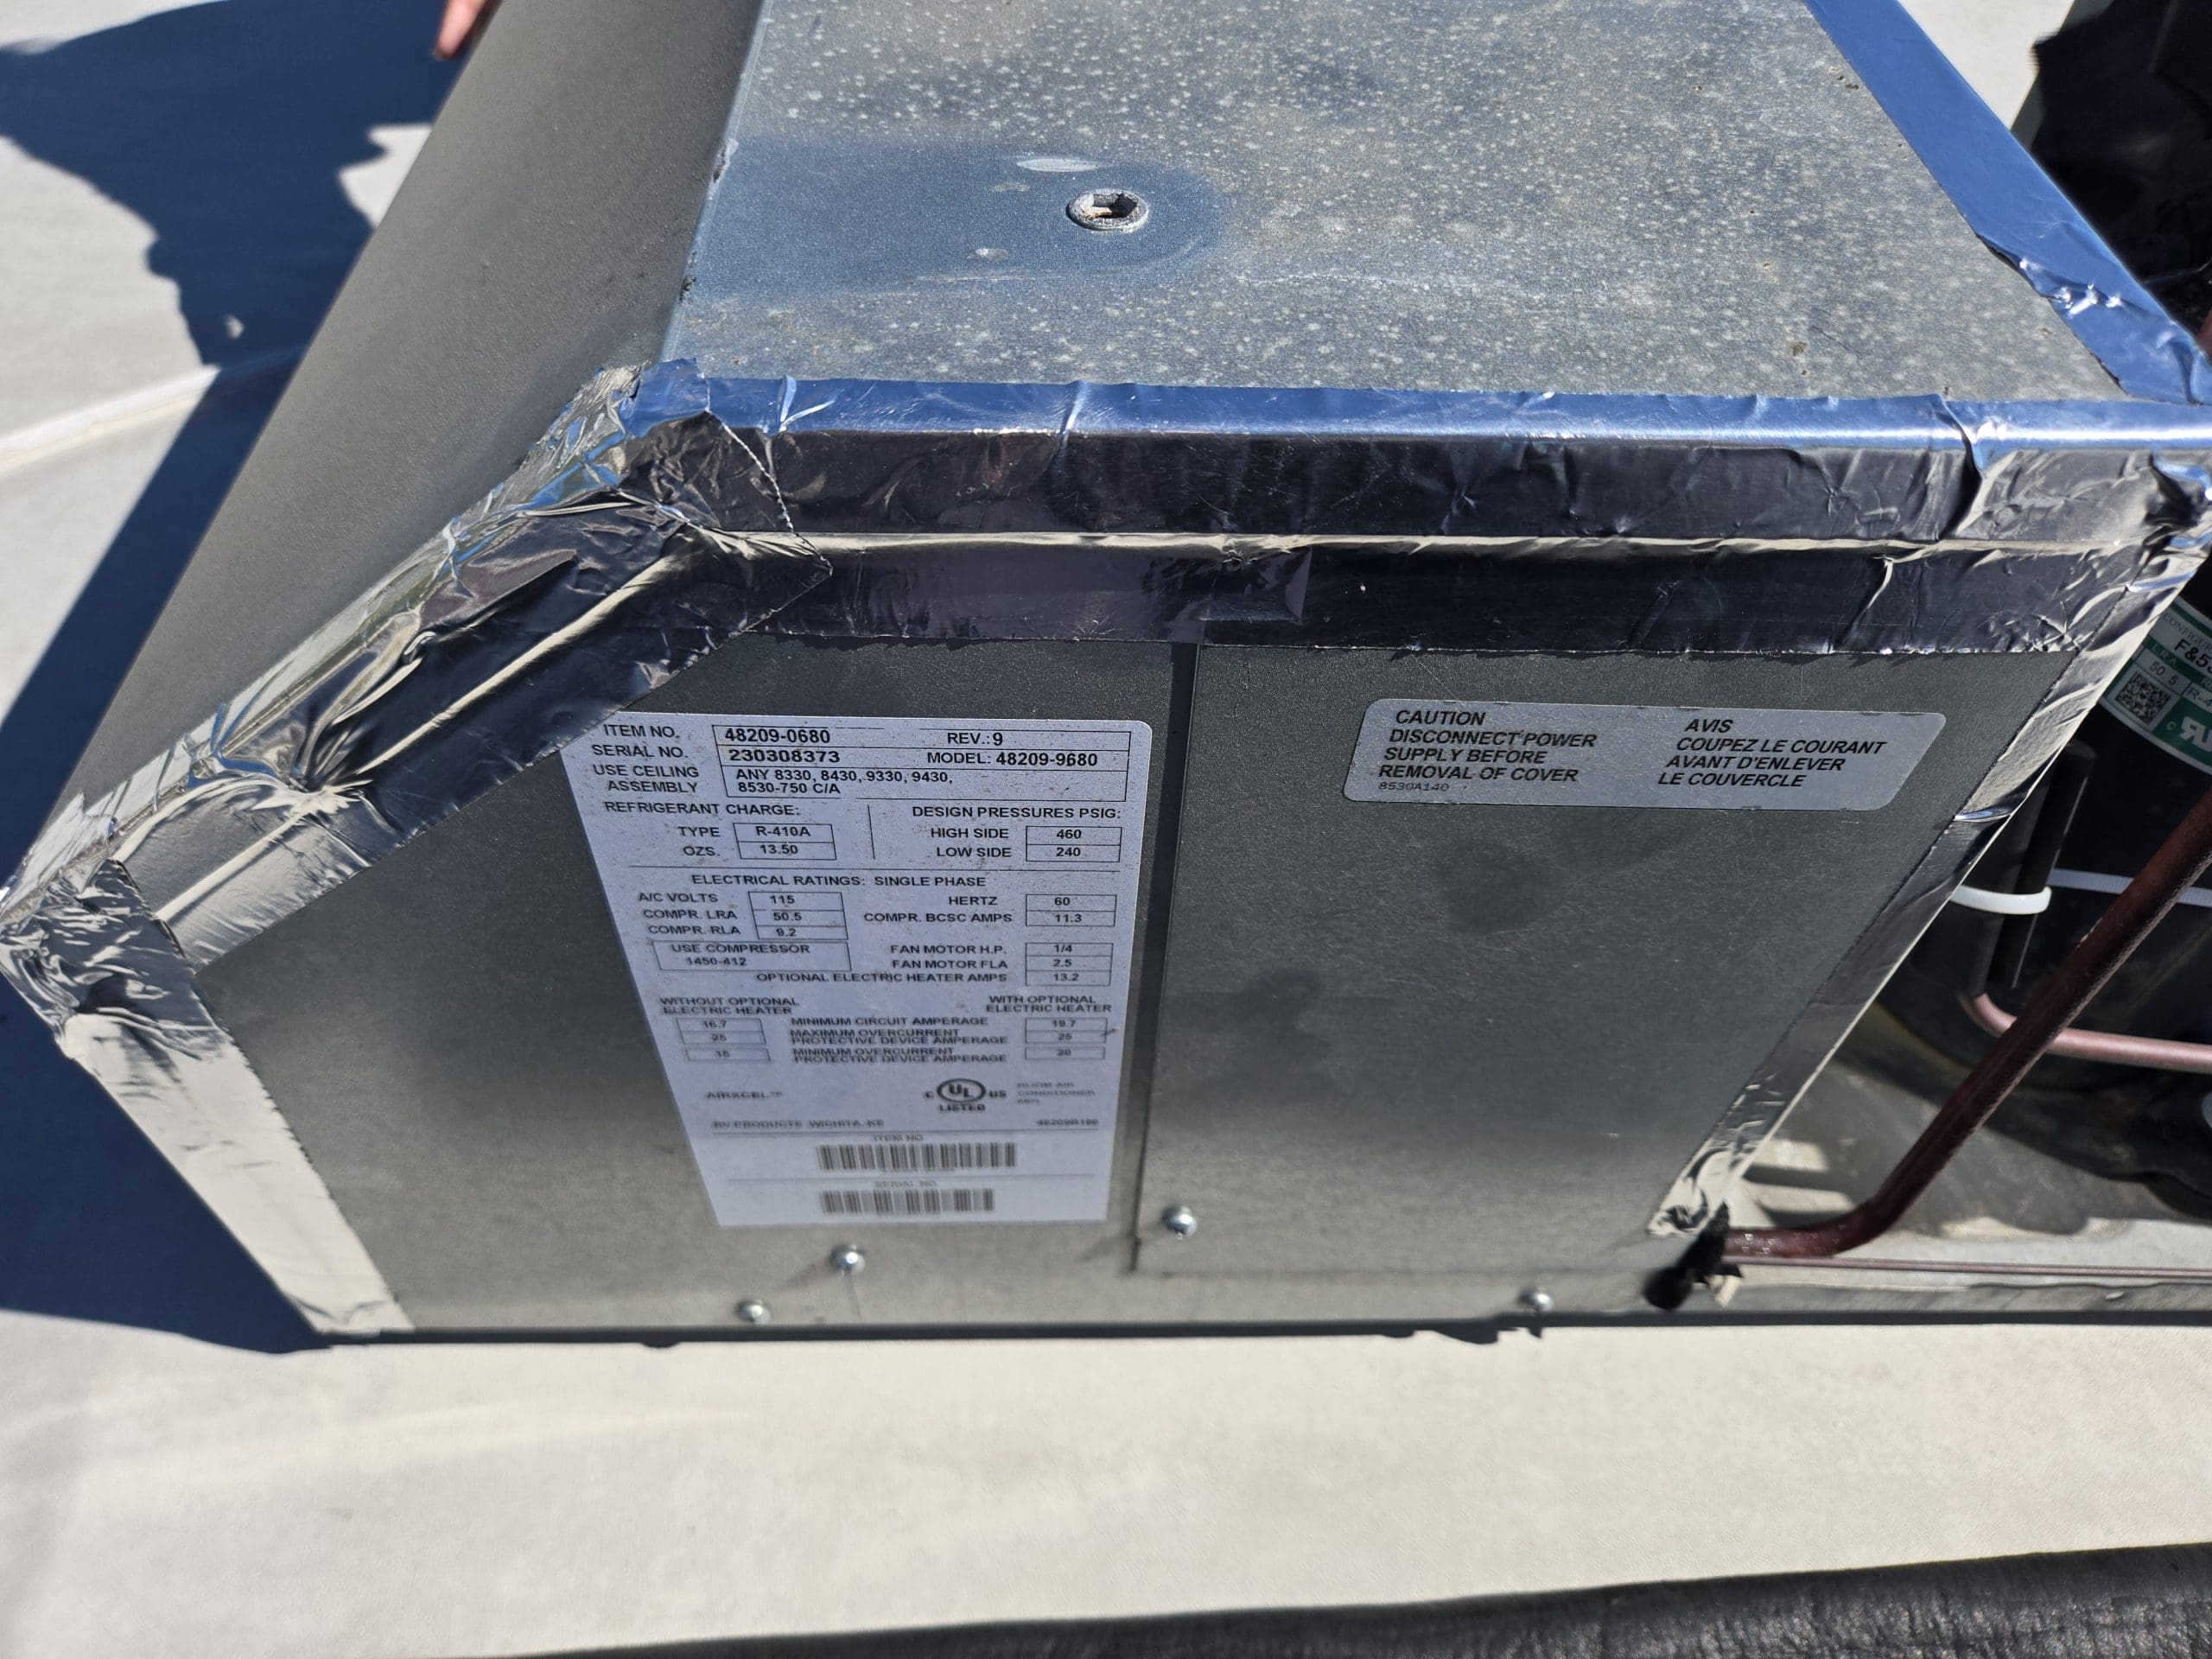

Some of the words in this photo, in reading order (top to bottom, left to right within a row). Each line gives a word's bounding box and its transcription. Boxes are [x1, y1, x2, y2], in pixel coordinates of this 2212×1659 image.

[1395, 710, 1486, 725] CAUTION
[1685, 720, 1733, 733] AVIS
[605, 724, 646, 737] ITEM
[650, 726, 680, 738] NO.
[725, 728, 830, 743] 48209-0680
[992, 733, 1003, 745] 9
[1389, 729, 1521, 745] DISCONNECT
[1522, 733, 1597, 747] POWER
[1676, 738, 1759, 753] COUPEZ
[1760, 740, 1788, 753] LE
[1790, 740, 1886, 753] COURANT
[592, 744, 655, 757] SERIAL
[659, 747, 688, 758] NO.
[728, 749, 840, 762] 230308373
[1383, 747, 1462, 762] SUPPLY
[1466, 749, 1548, 764] BEFORE
[927, 753, 991, 765] MODEL:
[996, 753, 1098, 766] 48209-9680
[1666, 756, 1736, 769] AVANT
[1737, 757, 1846, 771] D'ENLEVER
[594, 765, 628, 776] USE
[632, 766, 699, 778] CEILING
[736, 770, 769, 779] ANY
[774, 770, 817, 782] 8330,
[821, 771, 861, 783] 8430,
[866, 771, 907, 784] 9330,
[912, 772, 953, 785] 9430,
[1379, 765, 1472, 779] REMOVAL
[1479, 767, 1507, 779] OF
[1510, 767, 1579, 781] COVER
[1658, 772, 1686, 785] LE
[1688, 773, 1807, 786] COUVERCLE
[608, 781, 698, 792] ASSEMBLY
[738, 783, 808, 793] 8530-750
[812, 783, 841, 794] C/A
[1379, 782, 1449, 791] 8530A140
[605, 802, 720, 814] REFRIGERANT
[726, 804, 800, 816] CHARGE:
[912, 806, 973, 817] DESIGN
[978, 807, 1074, 818] PRESSURES
[1079, 808, 1121, 818] PSIG:
[677, 826, 720, 837] TYPE
[755, 826, 810, 836] R-410A
[931, 829, 969, 838] HIGH
[974, 829, 1008, 838] SIDE
[1056, 830, 1081, 839] 460
[683, 846, 720, 856] OZS.
[760, 844, 798, 855] 13.50
[937, 848, 972, 857] LOW
[976, 848, 1012, 857] SIDE
[1056, 848, 1080, 857] 240
[691, 874, 789, 885] ELECTRICAL
[794, 876, 865, 886] RATINGS:
[874, 877, 930, 886] SINGLE
[935, 877, 986, 887] PHASE
[639, 893, 664, 902] A/C
[667, 893, 718, 902] VOLTS
[770, 895, 795, 904] 115
[949, 896, 998, 905] HERTZ
[1054, 897, 1070, 906] 60
[643, 910, 702, 919] COMPR.
[707, 911, 737, 919] LRA
[773, 912, 802, 921] 50.5
[864, 913, 922, 923] COMPR.
[925, 913, 967, 923] BCSC
[971, 913, 1013, 923] AMPS
[1054, 914, 1083, 923] 11.3
[648, 925, 707, 935] COMPR.
[710, 926, 741, 935] RLA
[776, 928, 797, 937] 9.2
[671, 944, 702, 952] USE
[706, 944, 810, 953] COMPRESSOR
[891, 945, 919, 954] FAN
[925, 945, 976, 954] MOTOR
[980, 945, 1007, 954] H.P.
[1054, 944, 1072, 953] 1/4
[686, 957, 747, 966] 1450-412
[981, 960, 1007, 969] FLA
[1052, 959, 1071, 968] 2.5
[757, 973, 830, 982] OPTIONAL
[833, 973, 903, 982] ELECTRIC
[1053, 973, 1079, 982] 13.2
[791, 1017, 851, 1026] MINIMUM
[912, 1017, 988, 1026] AMPERAGE
[855, 1047, 954, 1056] OVERCURRENT
[794, 1055, 876, 1064] PROTECTIVE
